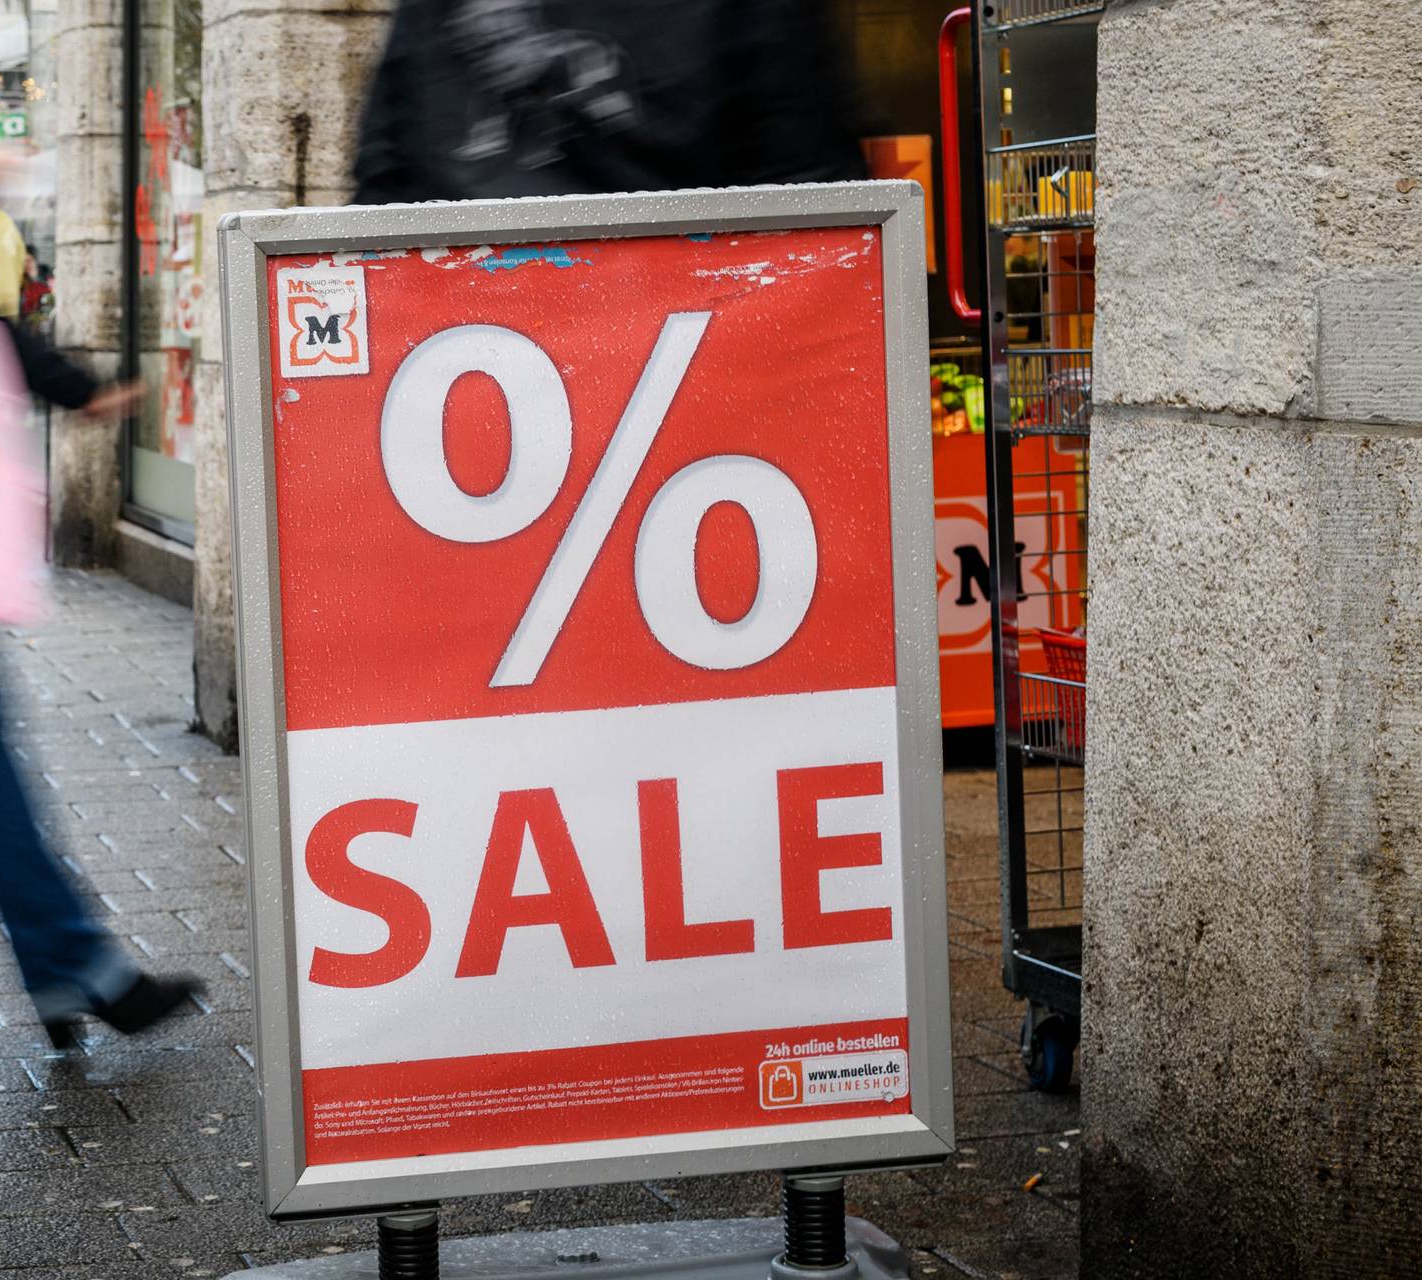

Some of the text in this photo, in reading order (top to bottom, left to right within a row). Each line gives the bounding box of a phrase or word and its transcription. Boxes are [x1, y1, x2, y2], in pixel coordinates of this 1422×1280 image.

[305, 314, 341, 345] M
[381, 311, 818, 688] %
[304, 761, 893, 988] SALE
[766, 1033, 899, 1058] 24h online bestellen
[808, 1061, 900, 1081] www.mueller.de
[376, 1125, 402, 1134] Solange
